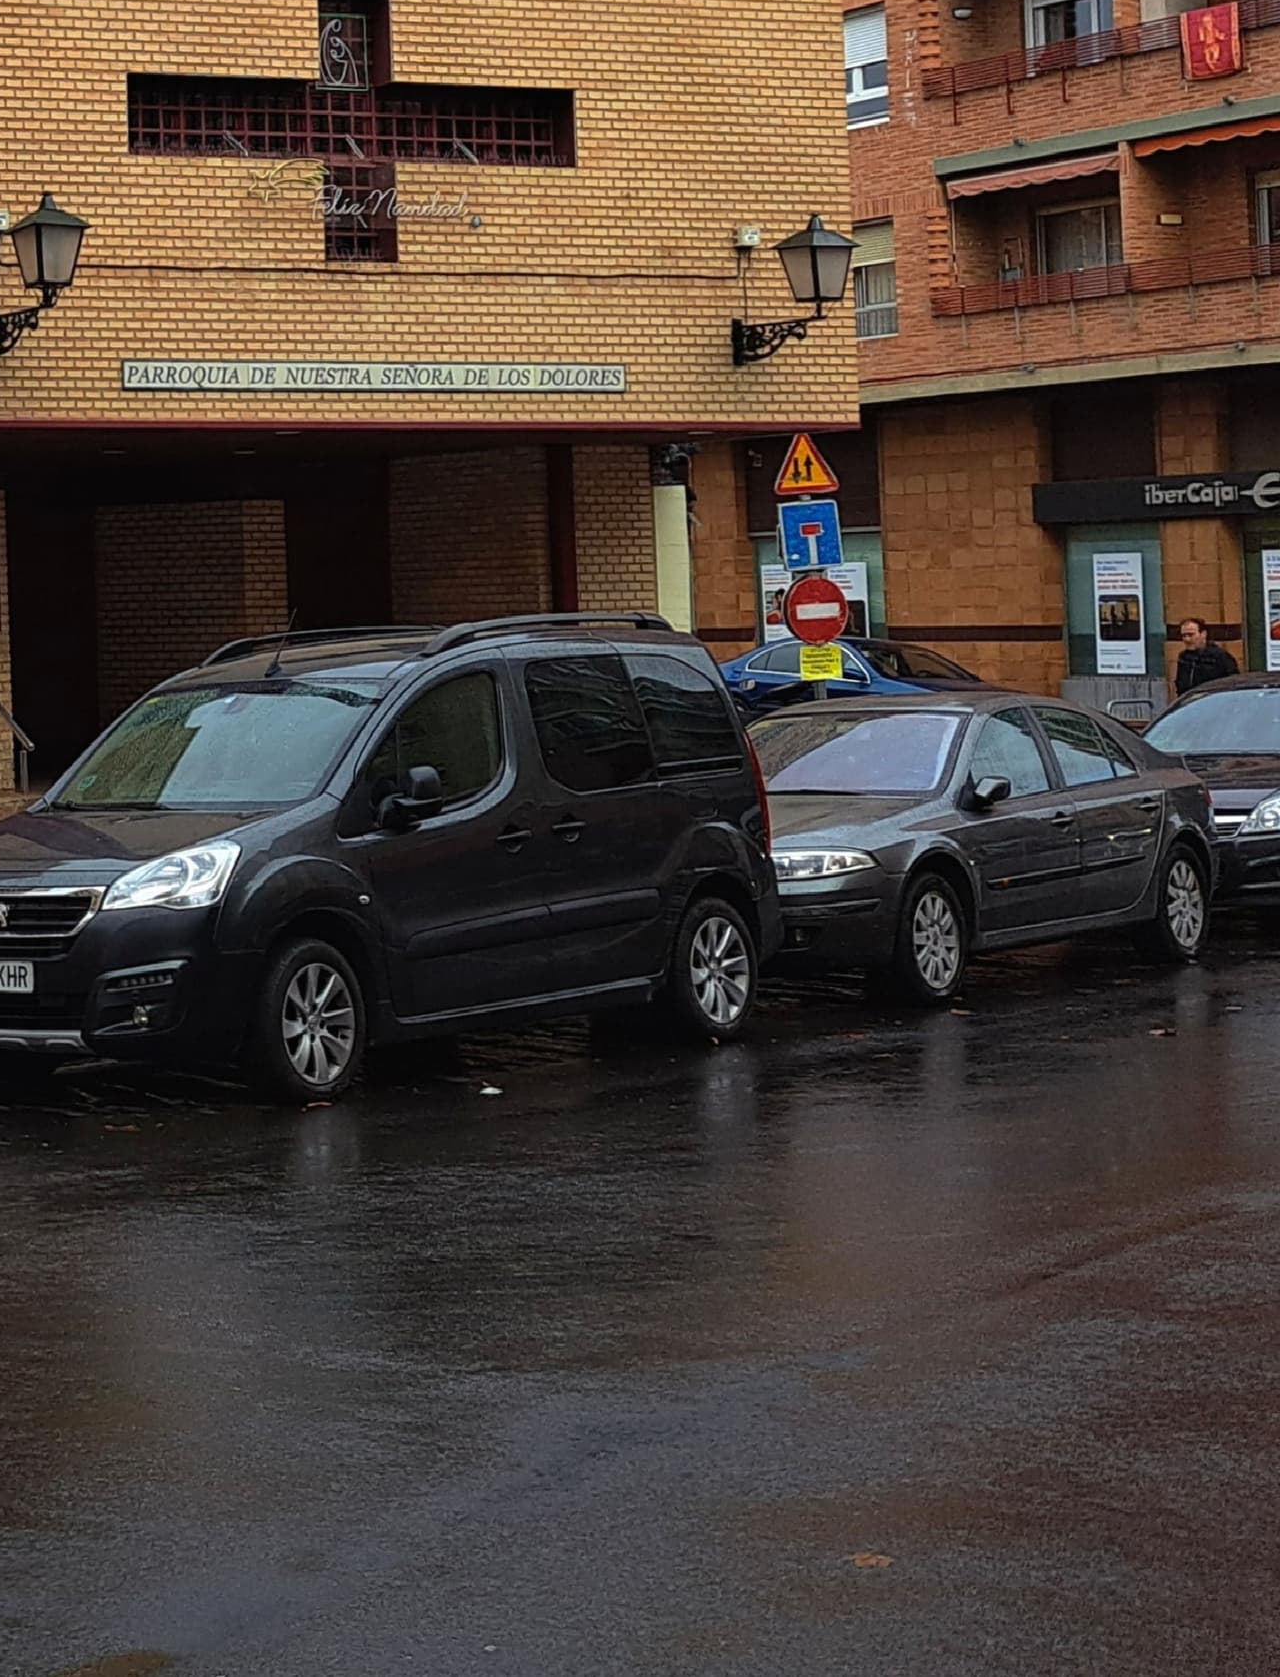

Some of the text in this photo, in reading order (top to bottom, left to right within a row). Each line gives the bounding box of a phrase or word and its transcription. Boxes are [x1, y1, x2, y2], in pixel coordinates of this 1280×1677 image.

[308, 184, 468, 222] Feliz Navidad
[126, 364, 621, 387] PARROQUIA DE NUESTRA SEÑORA DE LOS DOLORES
